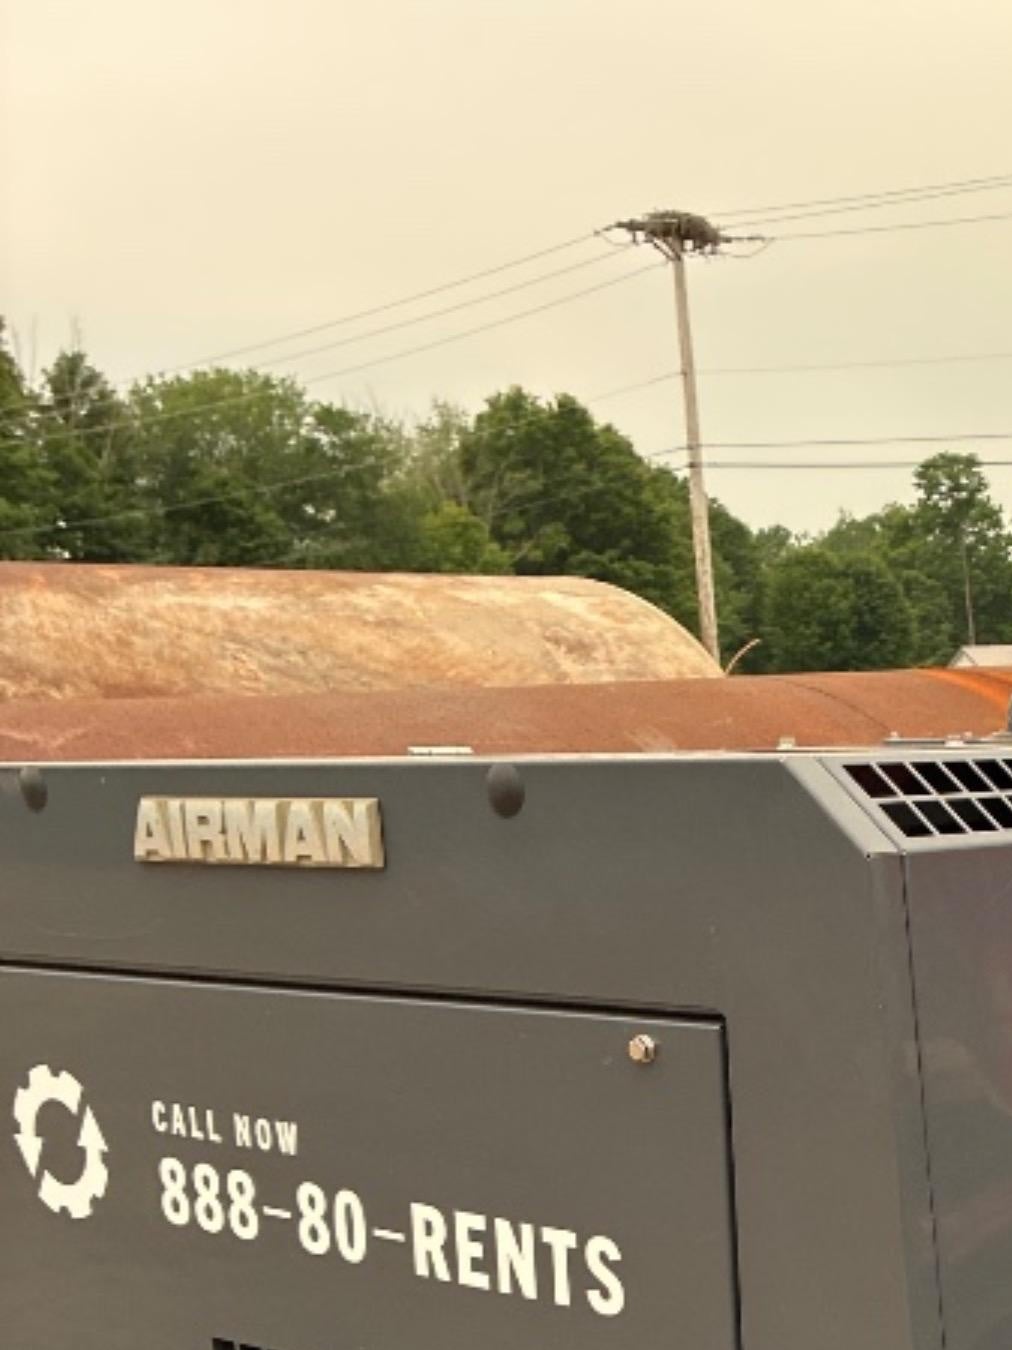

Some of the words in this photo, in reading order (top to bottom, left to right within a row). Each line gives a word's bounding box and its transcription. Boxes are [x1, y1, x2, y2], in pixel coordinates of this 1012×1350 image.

[134, 798, 374, 867] AIRMAN
[152, 1100, 222, 1143] CALL
[233, 1112, 298, 1156] NOW
[158, 1156, 625, 1316] 888-80-RENTS
